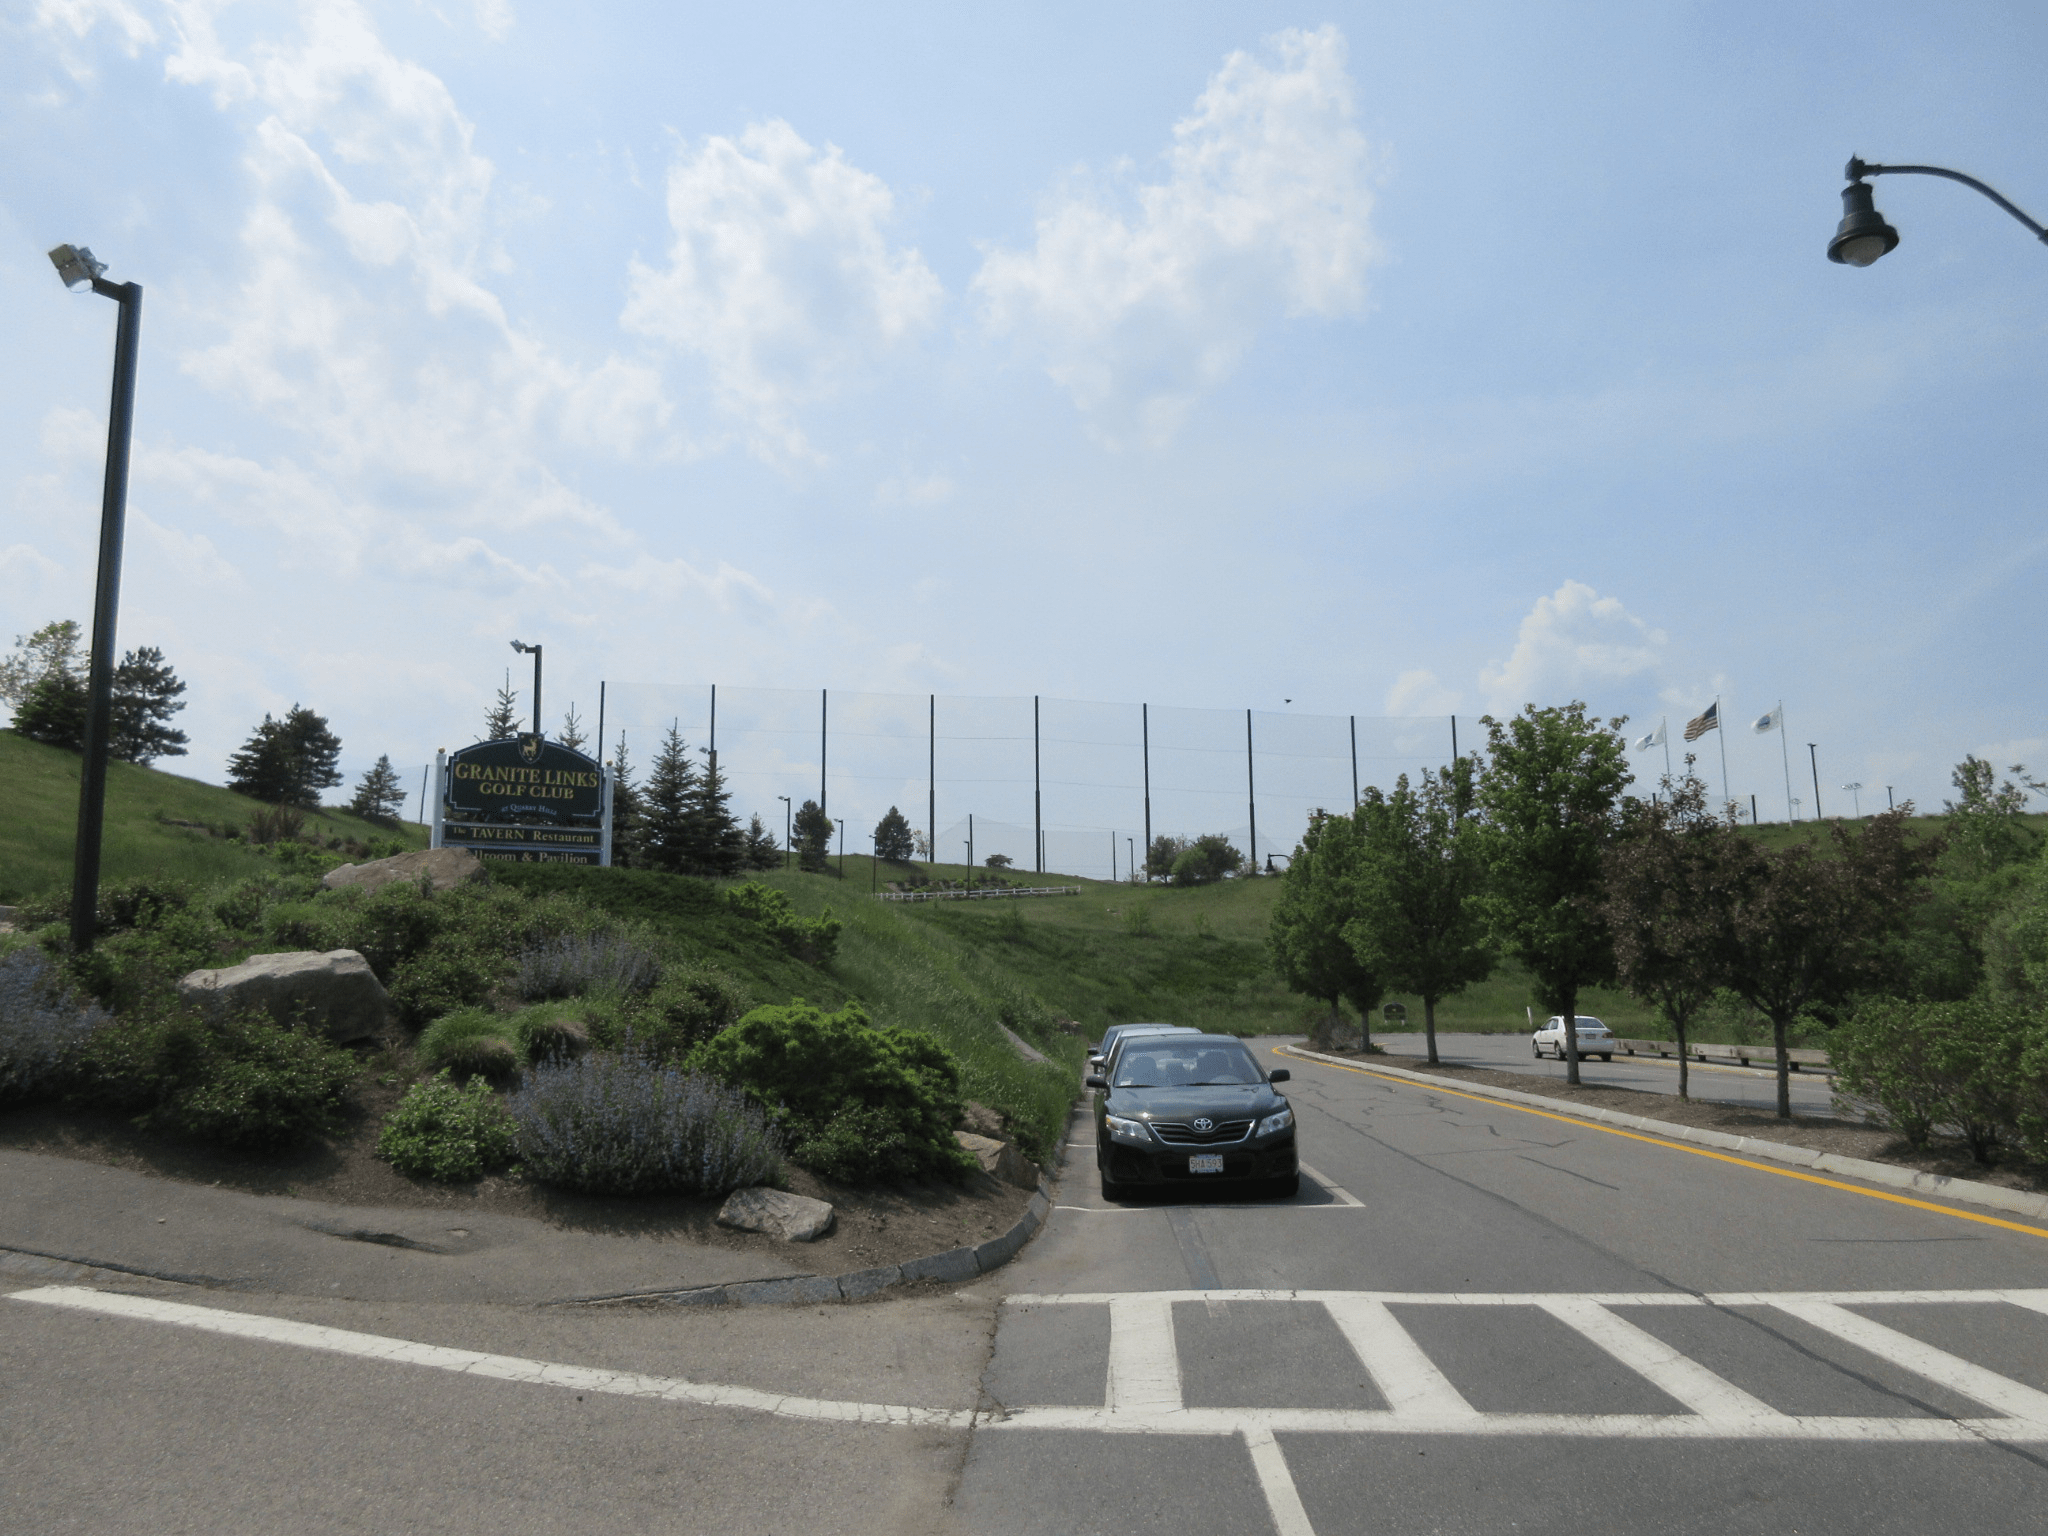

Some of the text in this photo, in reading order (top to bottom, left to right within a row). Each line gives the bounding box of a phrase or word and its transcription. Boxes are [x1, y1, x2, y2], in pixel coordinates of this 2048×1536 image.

[454, 762, 598, 788] GRANITE LINKS
[479, 781, 575, 799] GOLF CLUB
[470, 827, 525, 840] TAVERN
[533, 830, 595, 843] Restaurant
[474, 849, 588, 864] llroom & Pavilion
